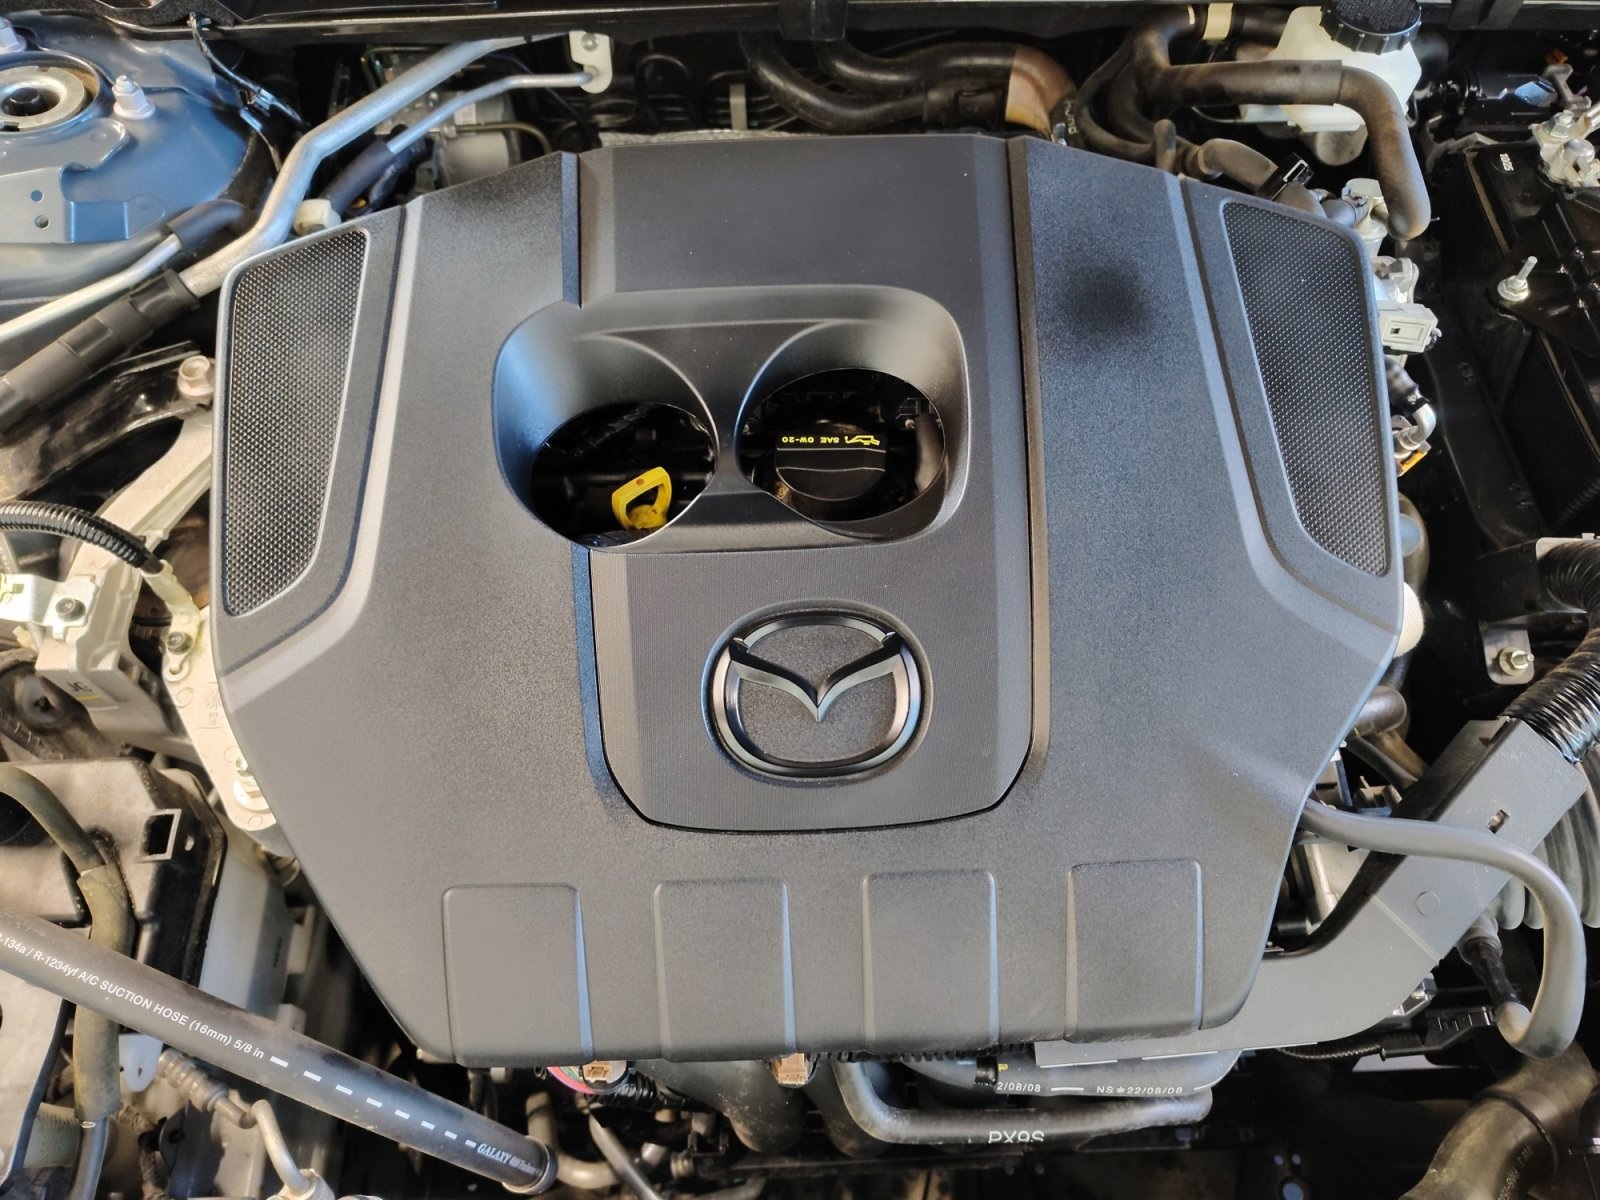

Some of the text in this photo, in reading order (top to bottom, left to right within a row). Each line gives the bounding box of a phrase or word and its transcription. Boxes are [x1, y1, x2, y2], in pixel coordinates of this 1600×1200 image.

[781, 436, 839, 444] SAE 0W-20
[33, 950, 79, 976] R-1234yf
[78, 971, 99, 985] A/C
[100, 980, 153, 1010] SUCTION
[153, 1003, 189, 1025] HOSE
[189, 1020, 232, 1046] (16mm)
[233, 1039, 253, 1054] 5/8
[252, 1047, 265, 1059] in
[477, 1143, 512, 1164] GALAXY
